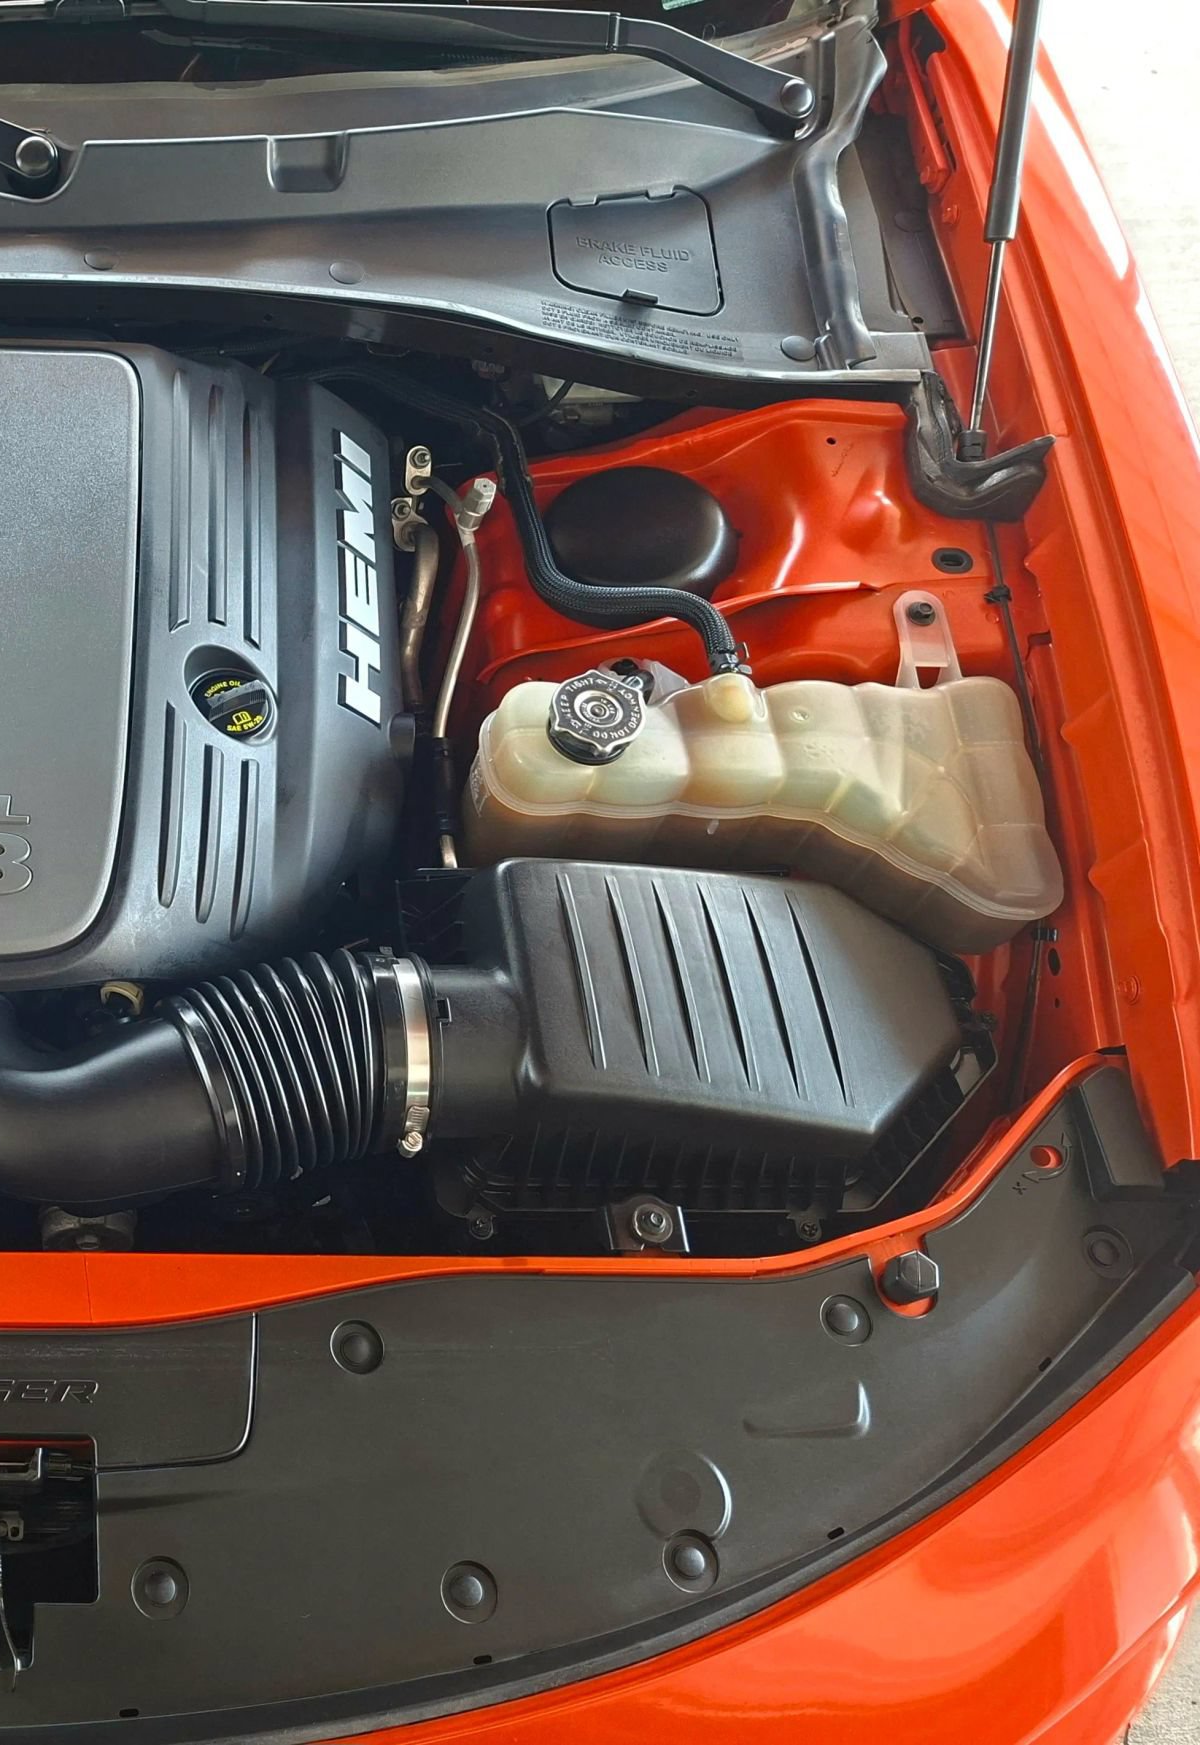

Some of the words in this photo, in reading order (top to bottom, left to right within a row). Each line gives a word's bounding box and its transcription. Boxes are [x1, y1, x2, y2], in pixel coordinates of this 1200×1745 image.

[576, 237, 637, 256] BRAKE
[640, 246, 690, 262] FLUID
[598, 254, 669, 273] ACCESS
[339, 431, 380, 724] HEMI
[204, 681, 228, 697] ENGINE
[565, 677, 594, 692] TIGHT
[617, 688, 637, 705] HOT
[628, 706, 640, 729] OPEN
[593, 730, 608, 739] DO
[609, 726, 630, 739] NOT
